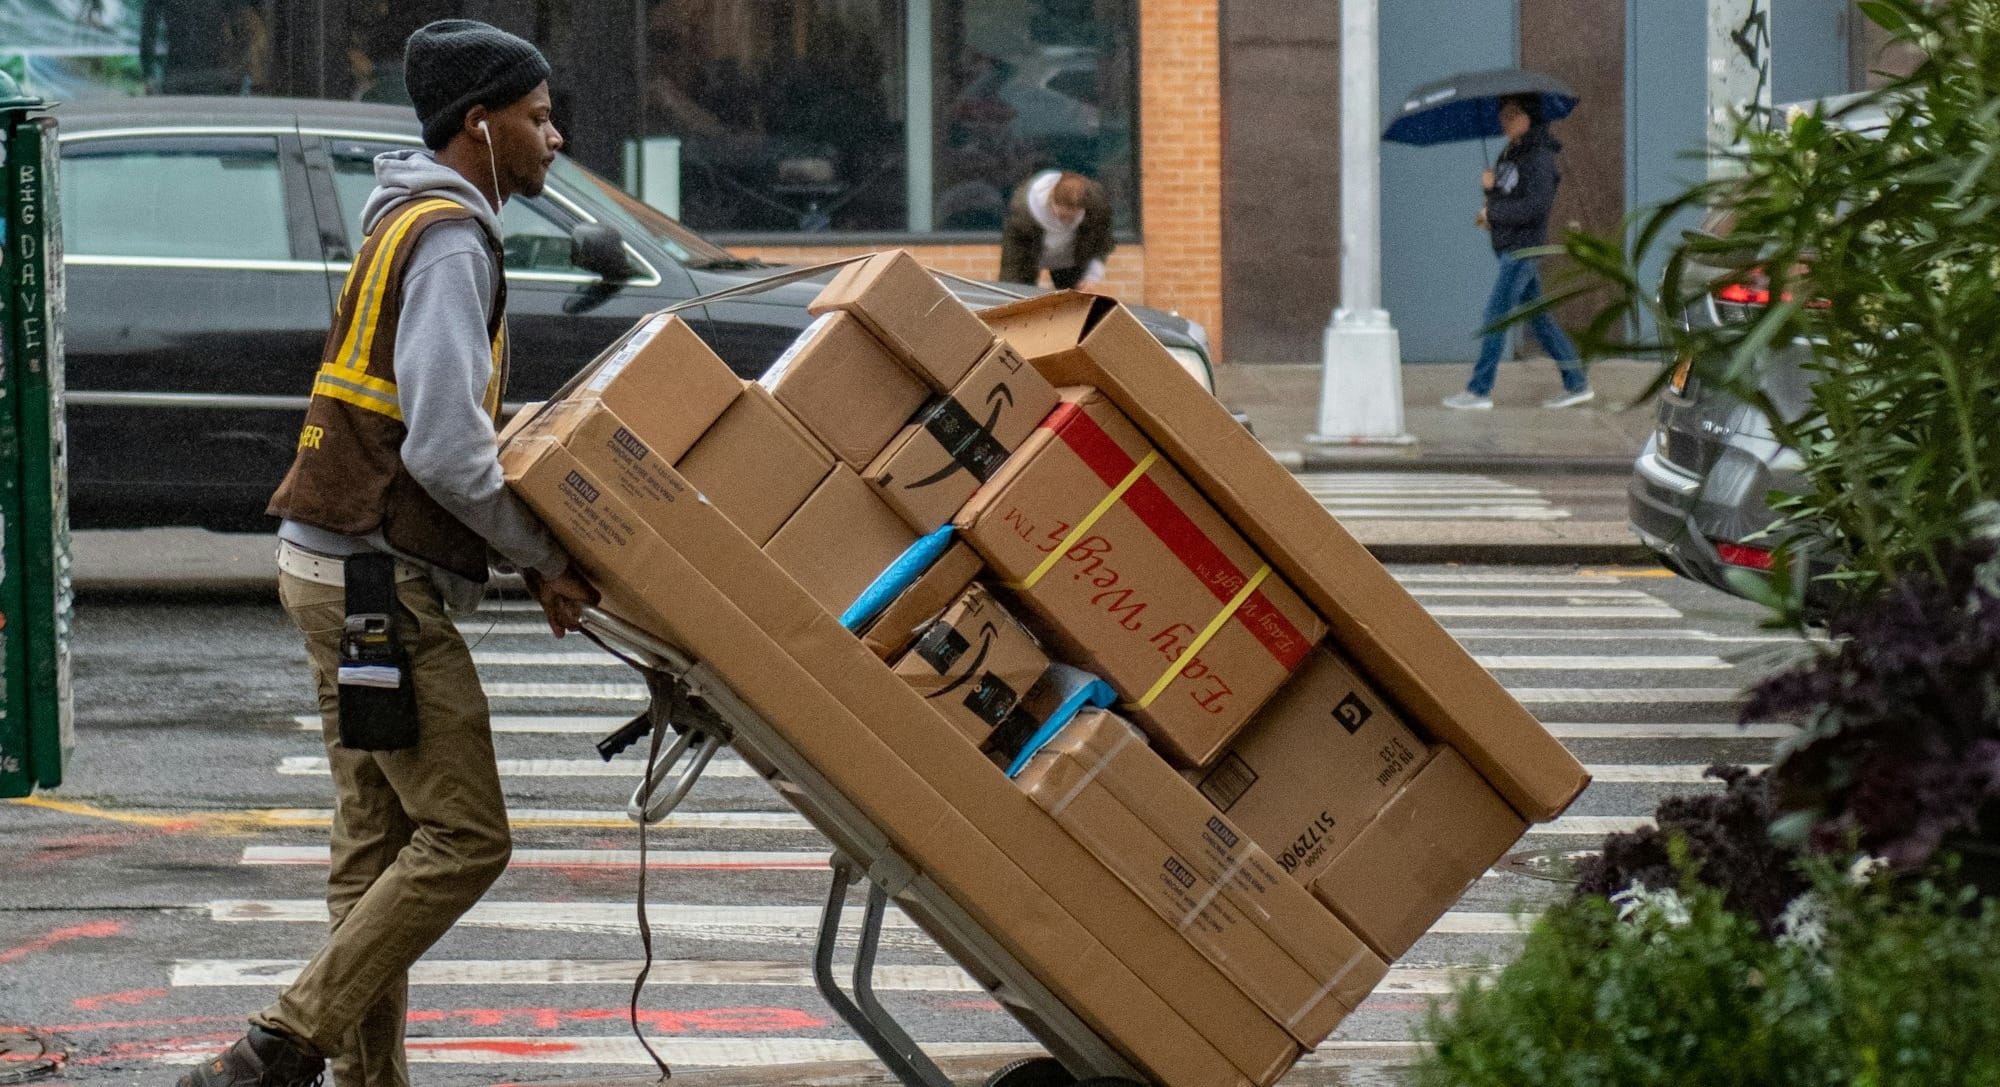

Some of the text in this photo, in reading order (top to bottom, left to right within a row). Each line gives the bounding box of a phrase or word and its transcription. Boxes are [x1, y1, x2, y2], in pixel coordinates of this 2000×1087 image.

[19, 165, 36, 225] BIG
[298, 425, 325, 453] ER
[614, 428, 647, 459] ULINE
[566, 471, 598, 502] ULINE
[1037, 521, 1150, 631] Weigh
[1215, 570, 1259, 618] Wigh
[1257, 611, 1295, 650] Easy
[1151, 623, 1235, 714] Easy
[1336, 698, 1365, 727] G
[1377, 735, 1404, 763] 3/33
[1375, 747, 1415, 787] 99 Count
[1206, 817, 1238, 846] ULINE
[1164, 858, 1194, 886] ULINE
